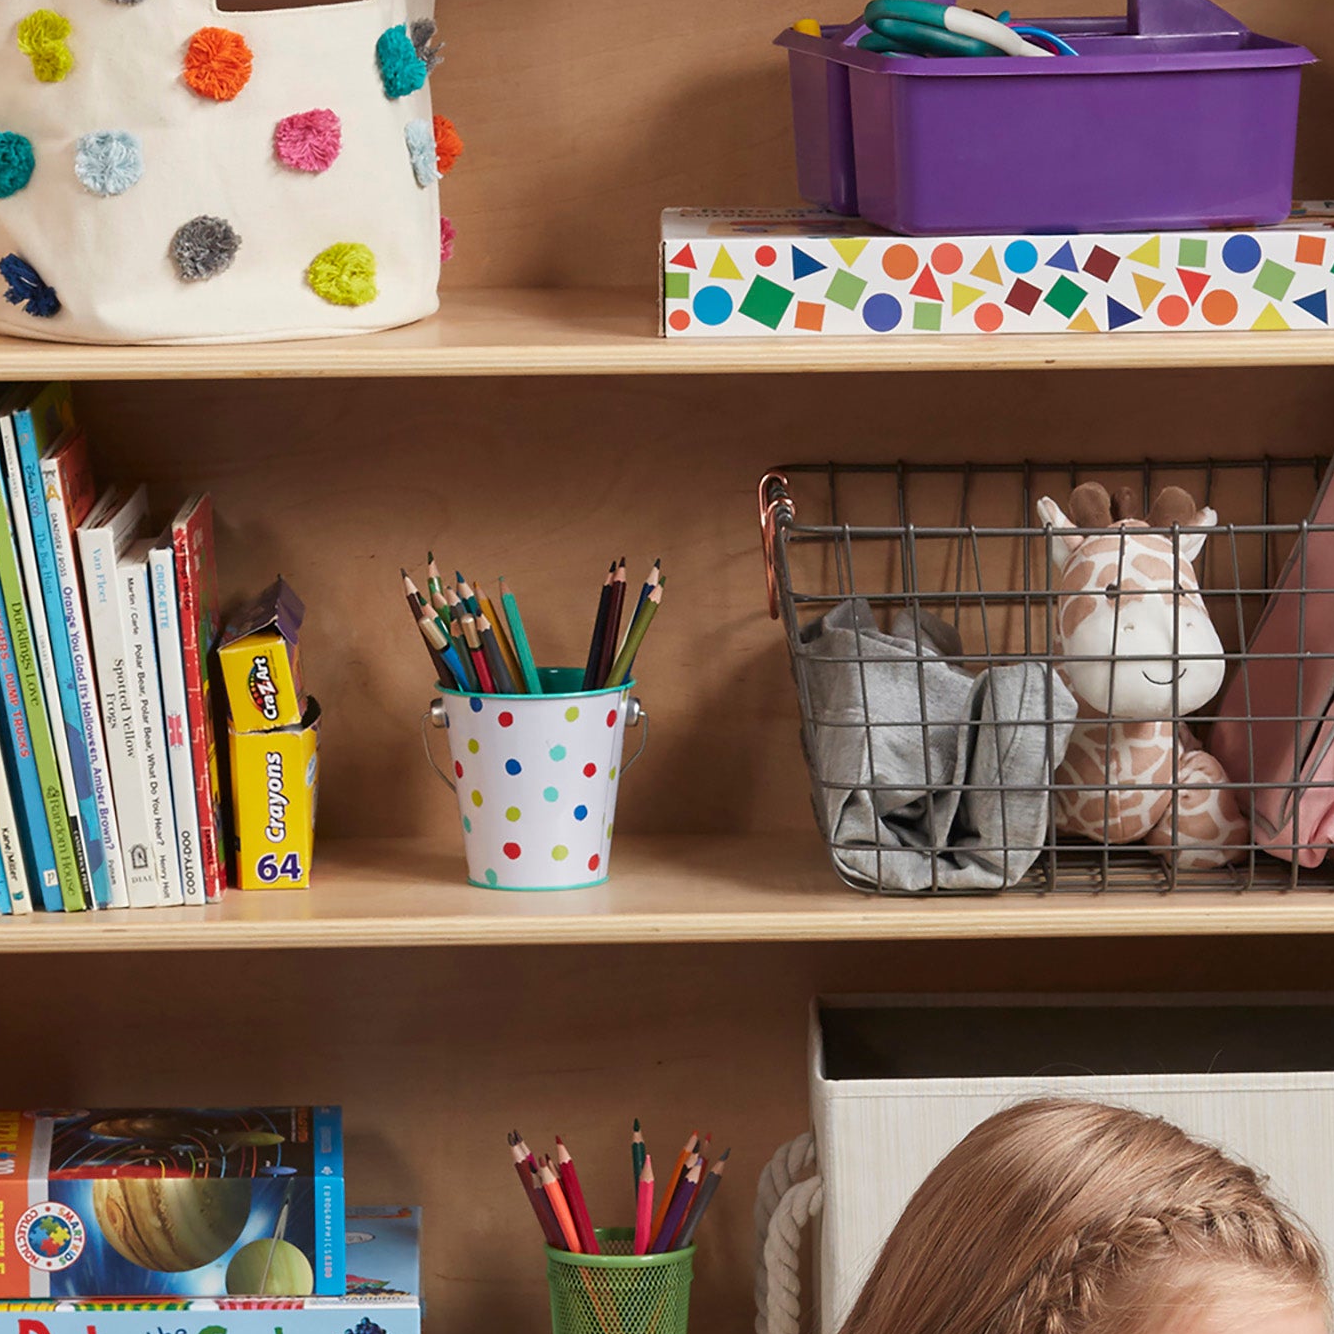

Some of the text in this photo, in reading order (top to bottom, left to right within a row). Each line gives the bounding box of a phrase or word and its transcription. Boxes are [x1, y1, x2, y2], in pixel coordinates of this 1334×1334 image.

[30, 496, 39, 518] Pooh
[43, 571, 54, 595] Hunt
[59, 556, 68, 577] ROSS
[93, 548, 108, 604] Van Fleet
[127, 577, 136, 605] Martin
[155, 563, 169, 629] CRICK-ETTE
[130, 614, 140, 636] Carle
[11, 602, 40, 707] Ducklings Love
[5, 673, 20, 707] DUMP
[106, 693, 117, 730] Frogs
[113, 659, 135, 759] Spotted Yellow
[10, 710, 31, 758] TRUCKS
[63, 586, 116, 851] Orange You Glad It's Halloween, Amber Brown?
[134, 644, 166, 846] Polar Bear, Polar Bear, What Do You Hear?
[265, 752, 290, 843] Crayons
[1, 827, 18, 882] Kane/Miller
[50, 798, 76, 898] Random House
[181, 830, 196, 895] COOTY-DOO
[256, 853, 302, 884] 64
[131, 874, 155, 884] DIAL
[159, 854, 171, 899] Henry Holt
[18, 1210, 38, 1264] COLLECTION
[58, 1208, 83, 1266] SMART KIDS
